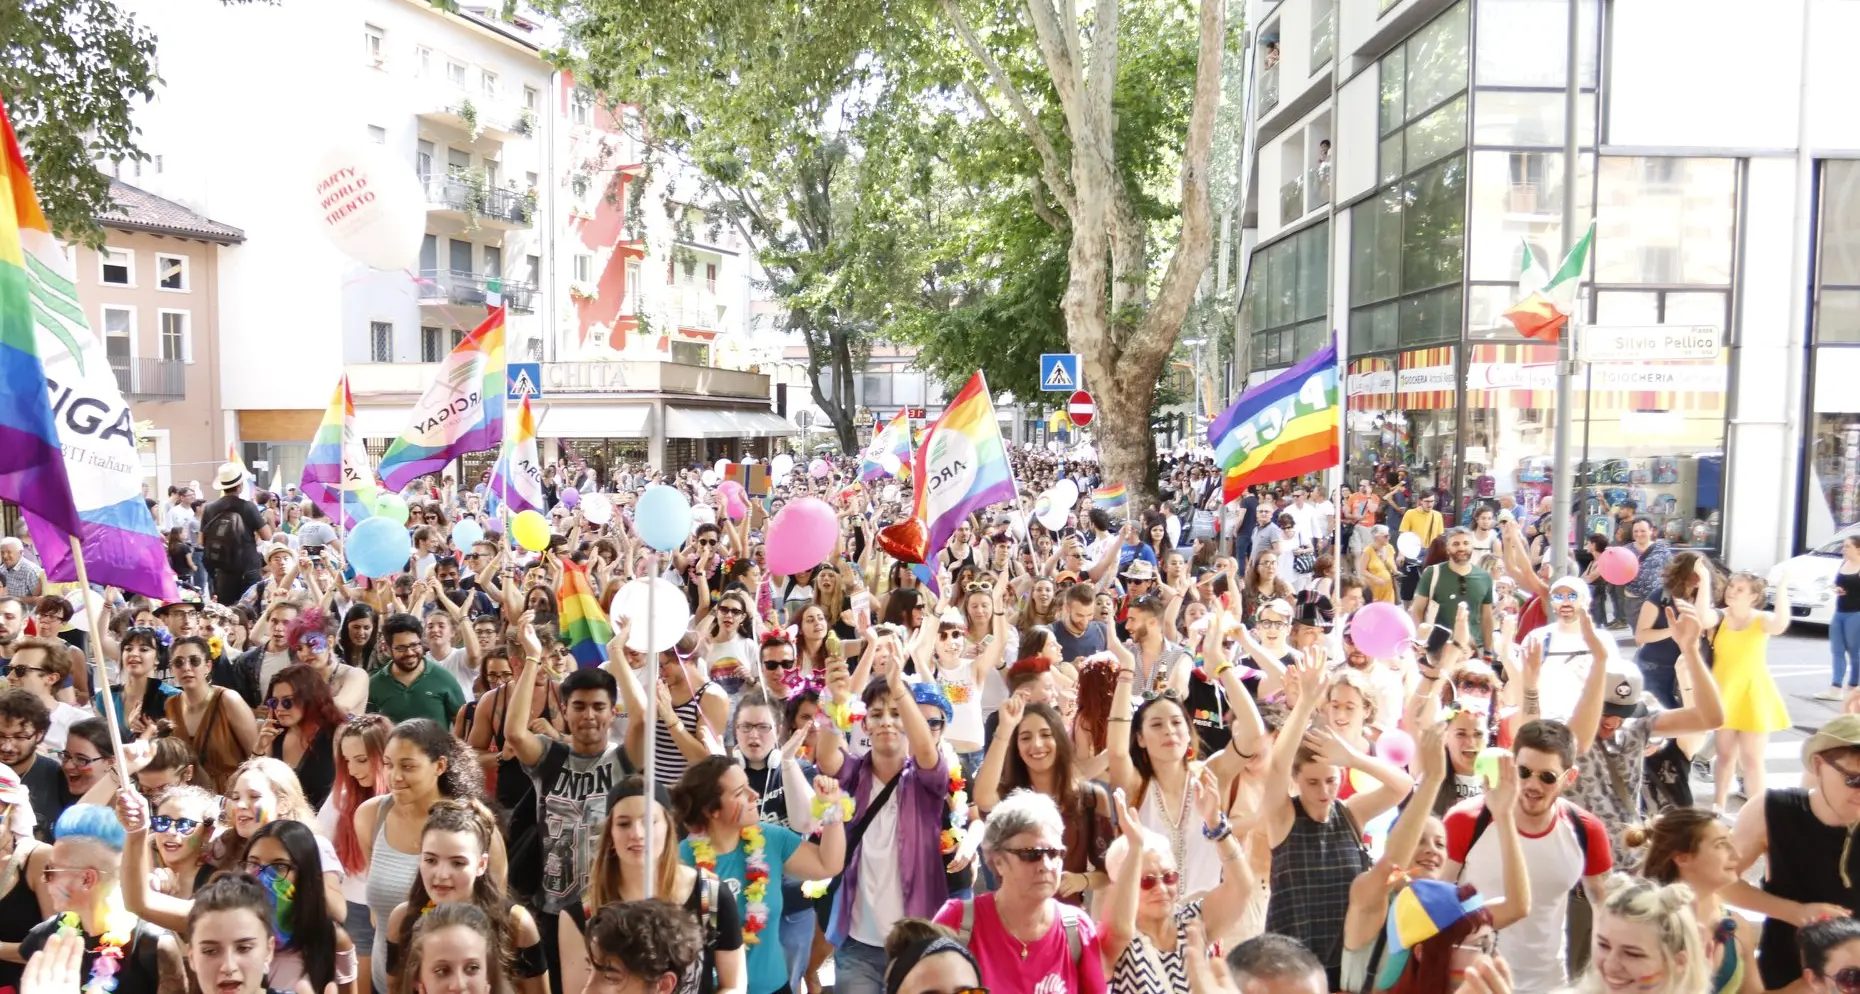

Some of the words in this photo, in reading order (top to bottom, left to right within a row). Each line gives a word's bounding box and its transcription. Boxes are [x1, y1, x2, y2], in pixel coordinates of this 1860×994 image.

[317, 166, 355, 195] PARTY
[321, 178, 367, 210] WORLD
[326, 191, 376, 226] TRENTO
[1615, 337, 1656, 349] Silvio
[1664, 336, 1713, 348] Pellico
[1608, 373, 1674, 383] GIOCHERIA
[46, 377, 134, 448] IGA
[1193, 719, 1213, 728] PRIDE
